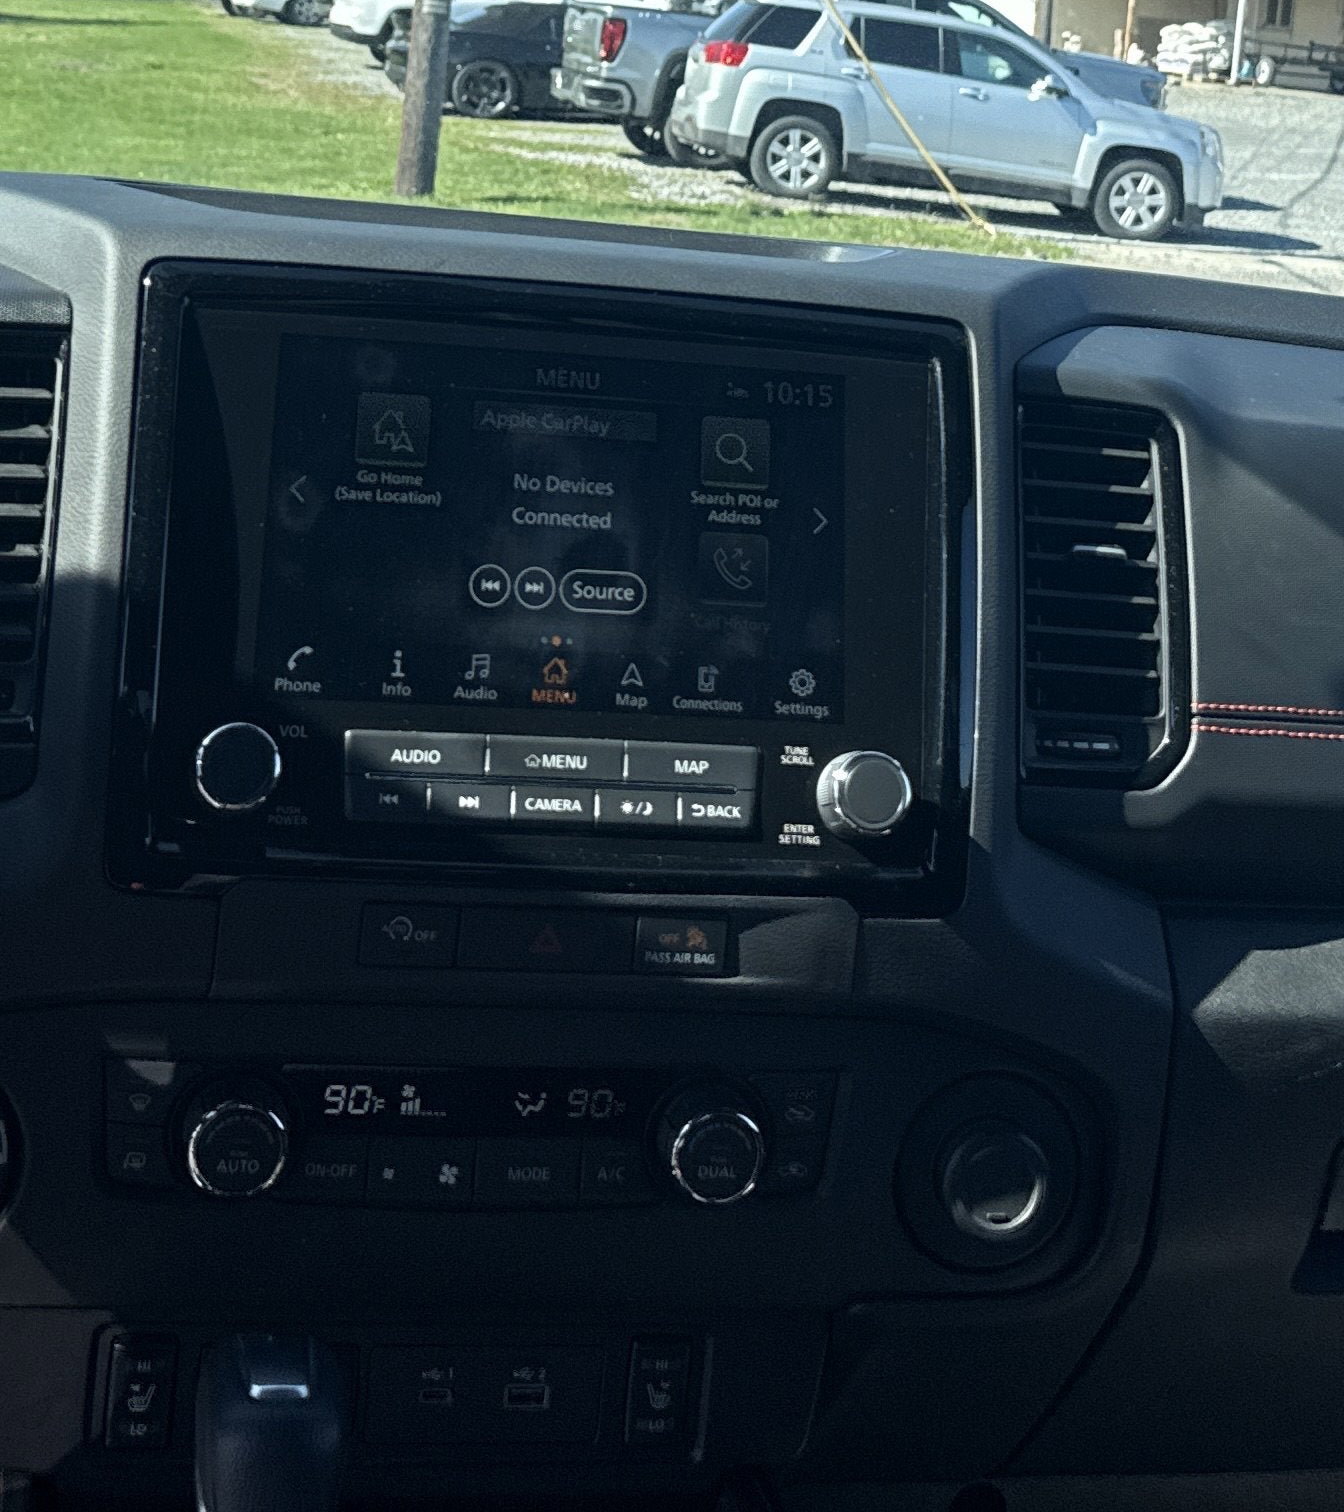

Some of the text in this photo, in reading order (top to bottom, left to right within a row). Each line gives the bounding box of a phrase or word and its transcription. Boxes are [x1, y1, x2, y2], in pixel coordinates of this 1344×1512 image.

[536, 368, 833, 407] MENU 10:15
[480, 408, 611, 437] Apple CarPlay
[357, 469, 424, 487] Go Home
[513, 473, 615, 497] No Devices
[334, 486, 441, 507] (Save Location)
[690, 490, 780, 509] Search POI or
[512, 507, 612, 529] Connected
[708, 509, 762, 525] Address
[572, 581, 635, 601] Source
[274, 677, 321, 693] Phone
[382, 682, 412, 697] Info
[454, 685, 497, 701] Audio
[531, 688, 577, 704] MENU
[616, 692, 648, 709] Map
[672, 695, 743, 712] Connections
[774, 700, 830, 719] Settings
[279, 724, 308, 738] VOL
[390, 748, 441, 764] AUDIO
[783, 745, 809, 755] TUNE
[541, 754, 588, 769] MENU
[674, 759, 710, 774] MAP
[780, 755, 815, 766] SCROLL
[524, 796, 582, 812] CAMERA
[706, 804, 741, 819] BACK
[783, 823, 815, 834] ENTER
[778, 834, 821, 846] SETTING
[645, 950, 715, 965] PASS AIR BAG
[216, 1158, 260, 1175] AUTO
[507, 1166, 551, 1181] MODE
[597, 1165, 626, 1181] A/C
[697, 1165, 737, 1179] DUAL
